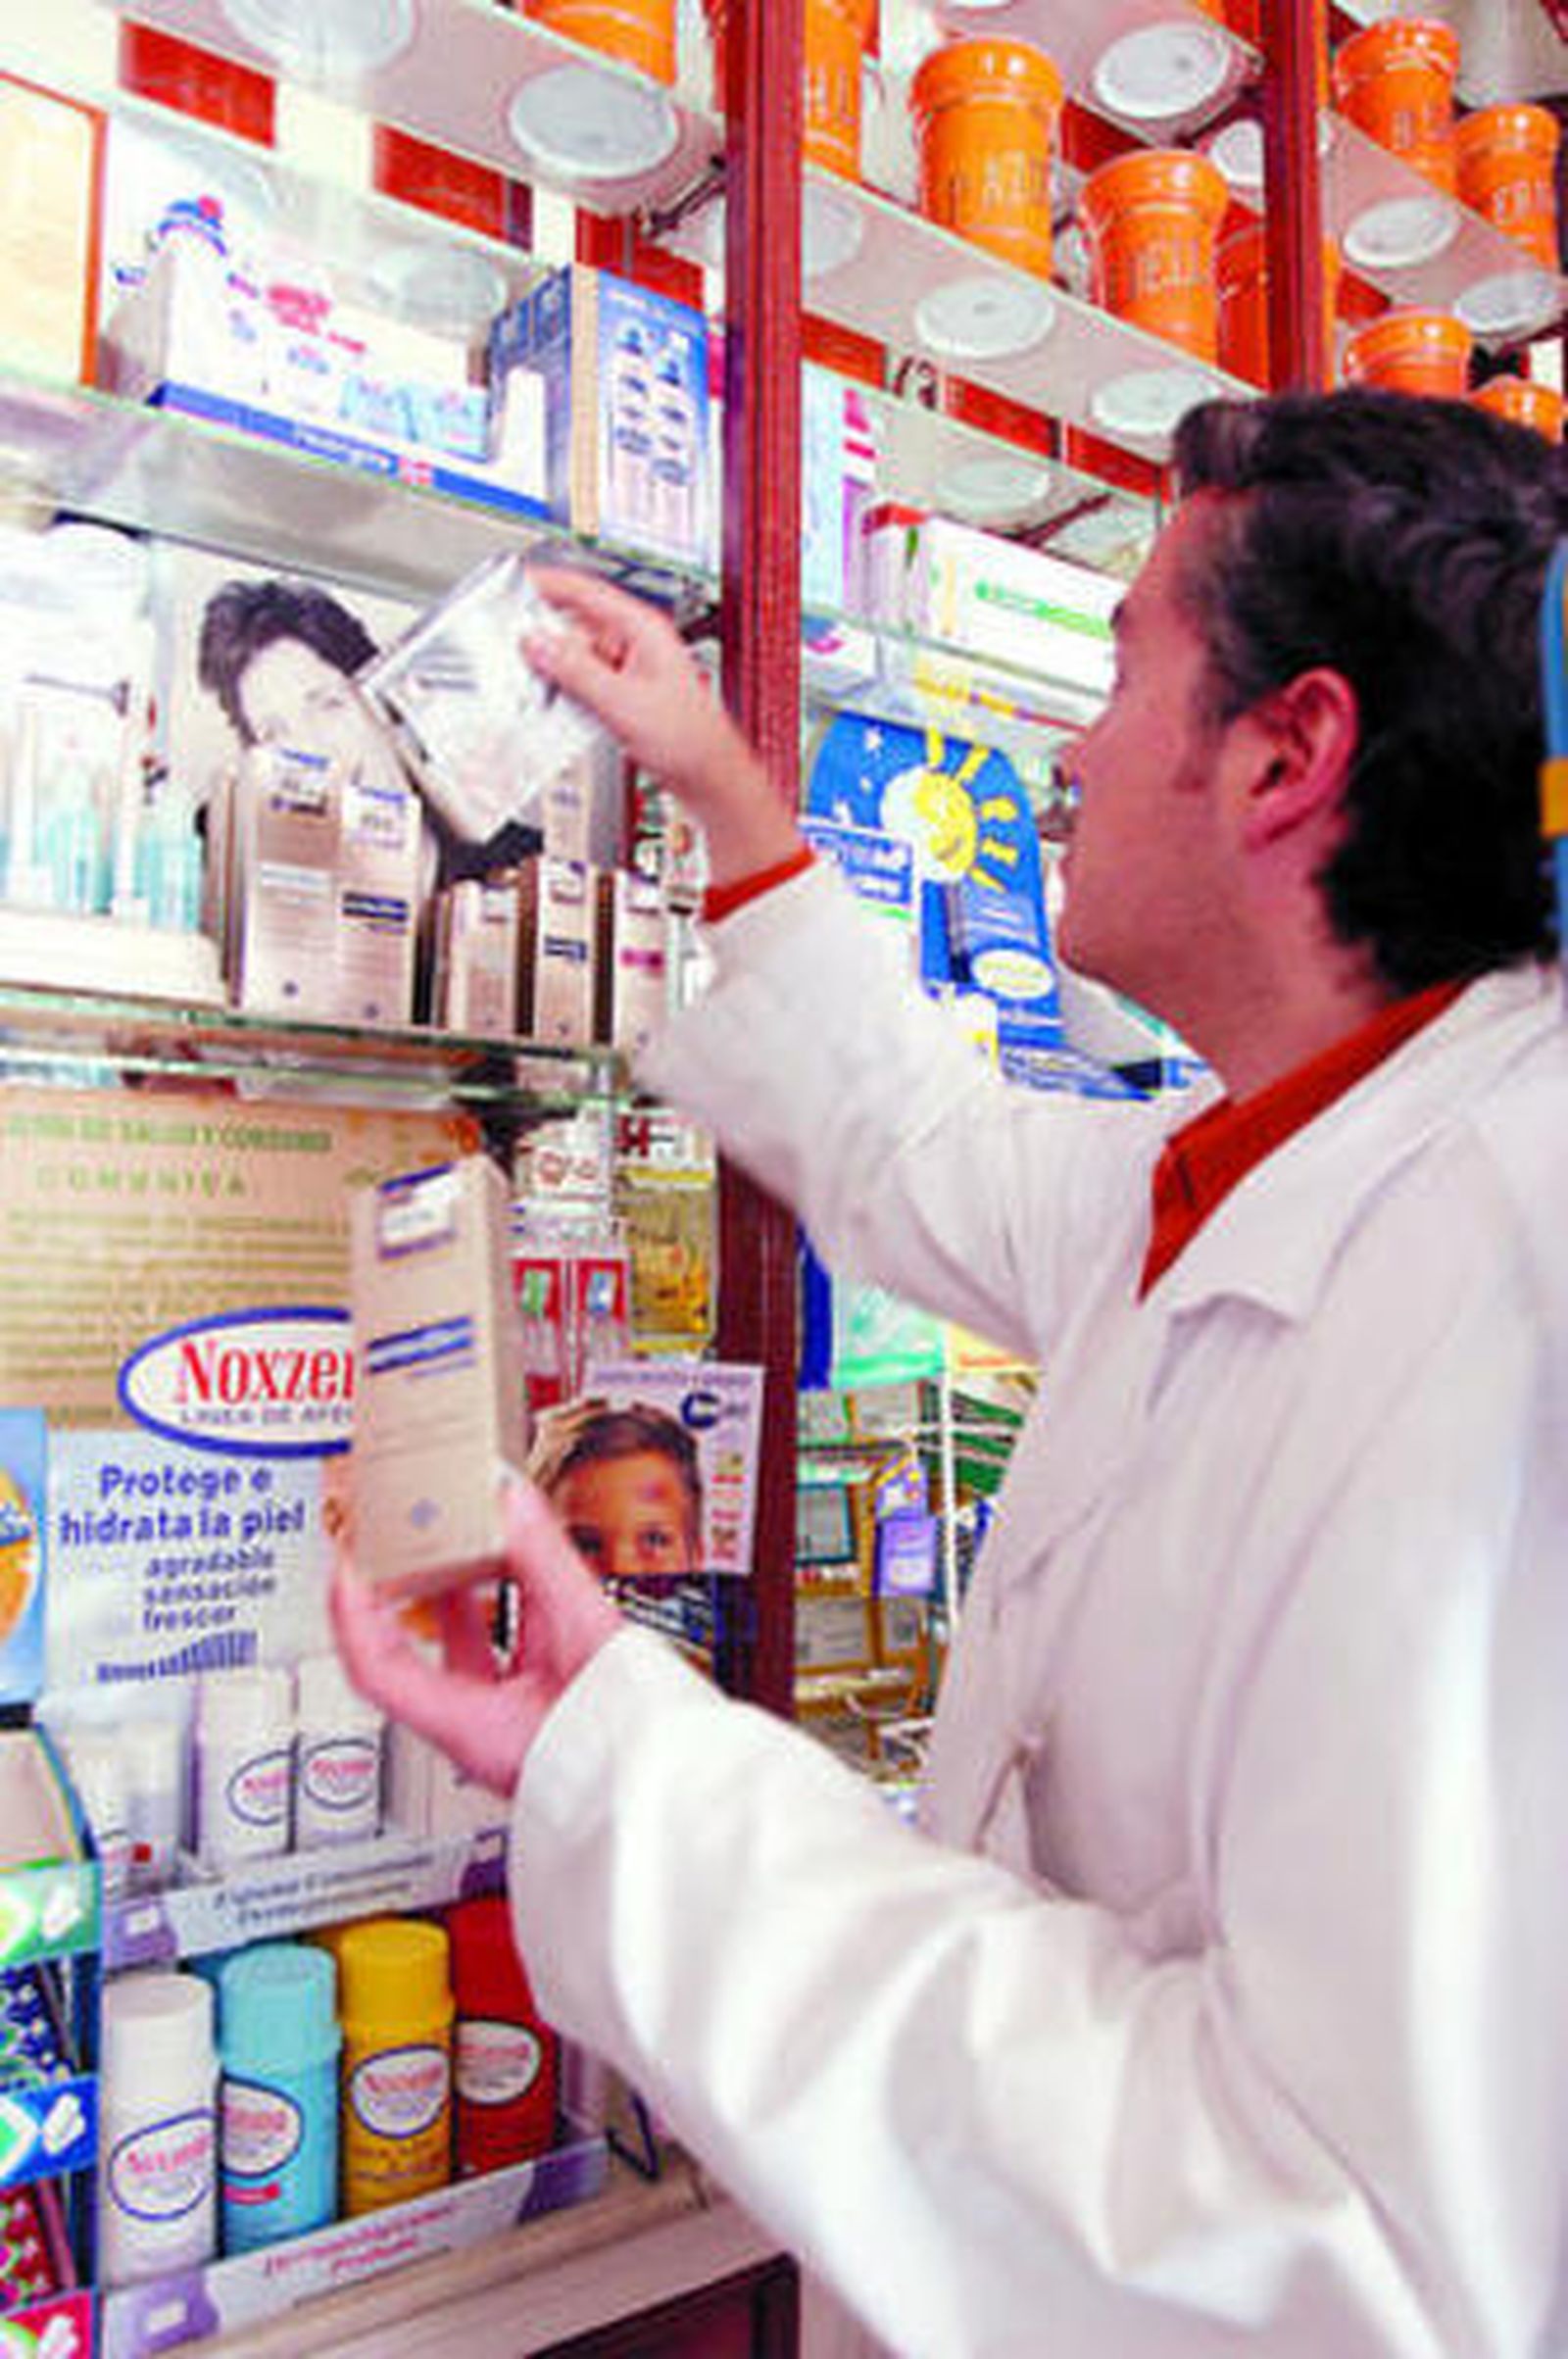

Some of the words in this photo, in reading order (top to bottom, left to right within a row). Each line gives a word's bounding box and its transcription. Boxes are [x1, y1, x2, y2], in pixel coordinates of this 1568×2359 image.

[100, 1464, 241, 1499] Protege
[60, 1506, 193, 1545] hidrata
[241, 1496, 305, 1543] piel
